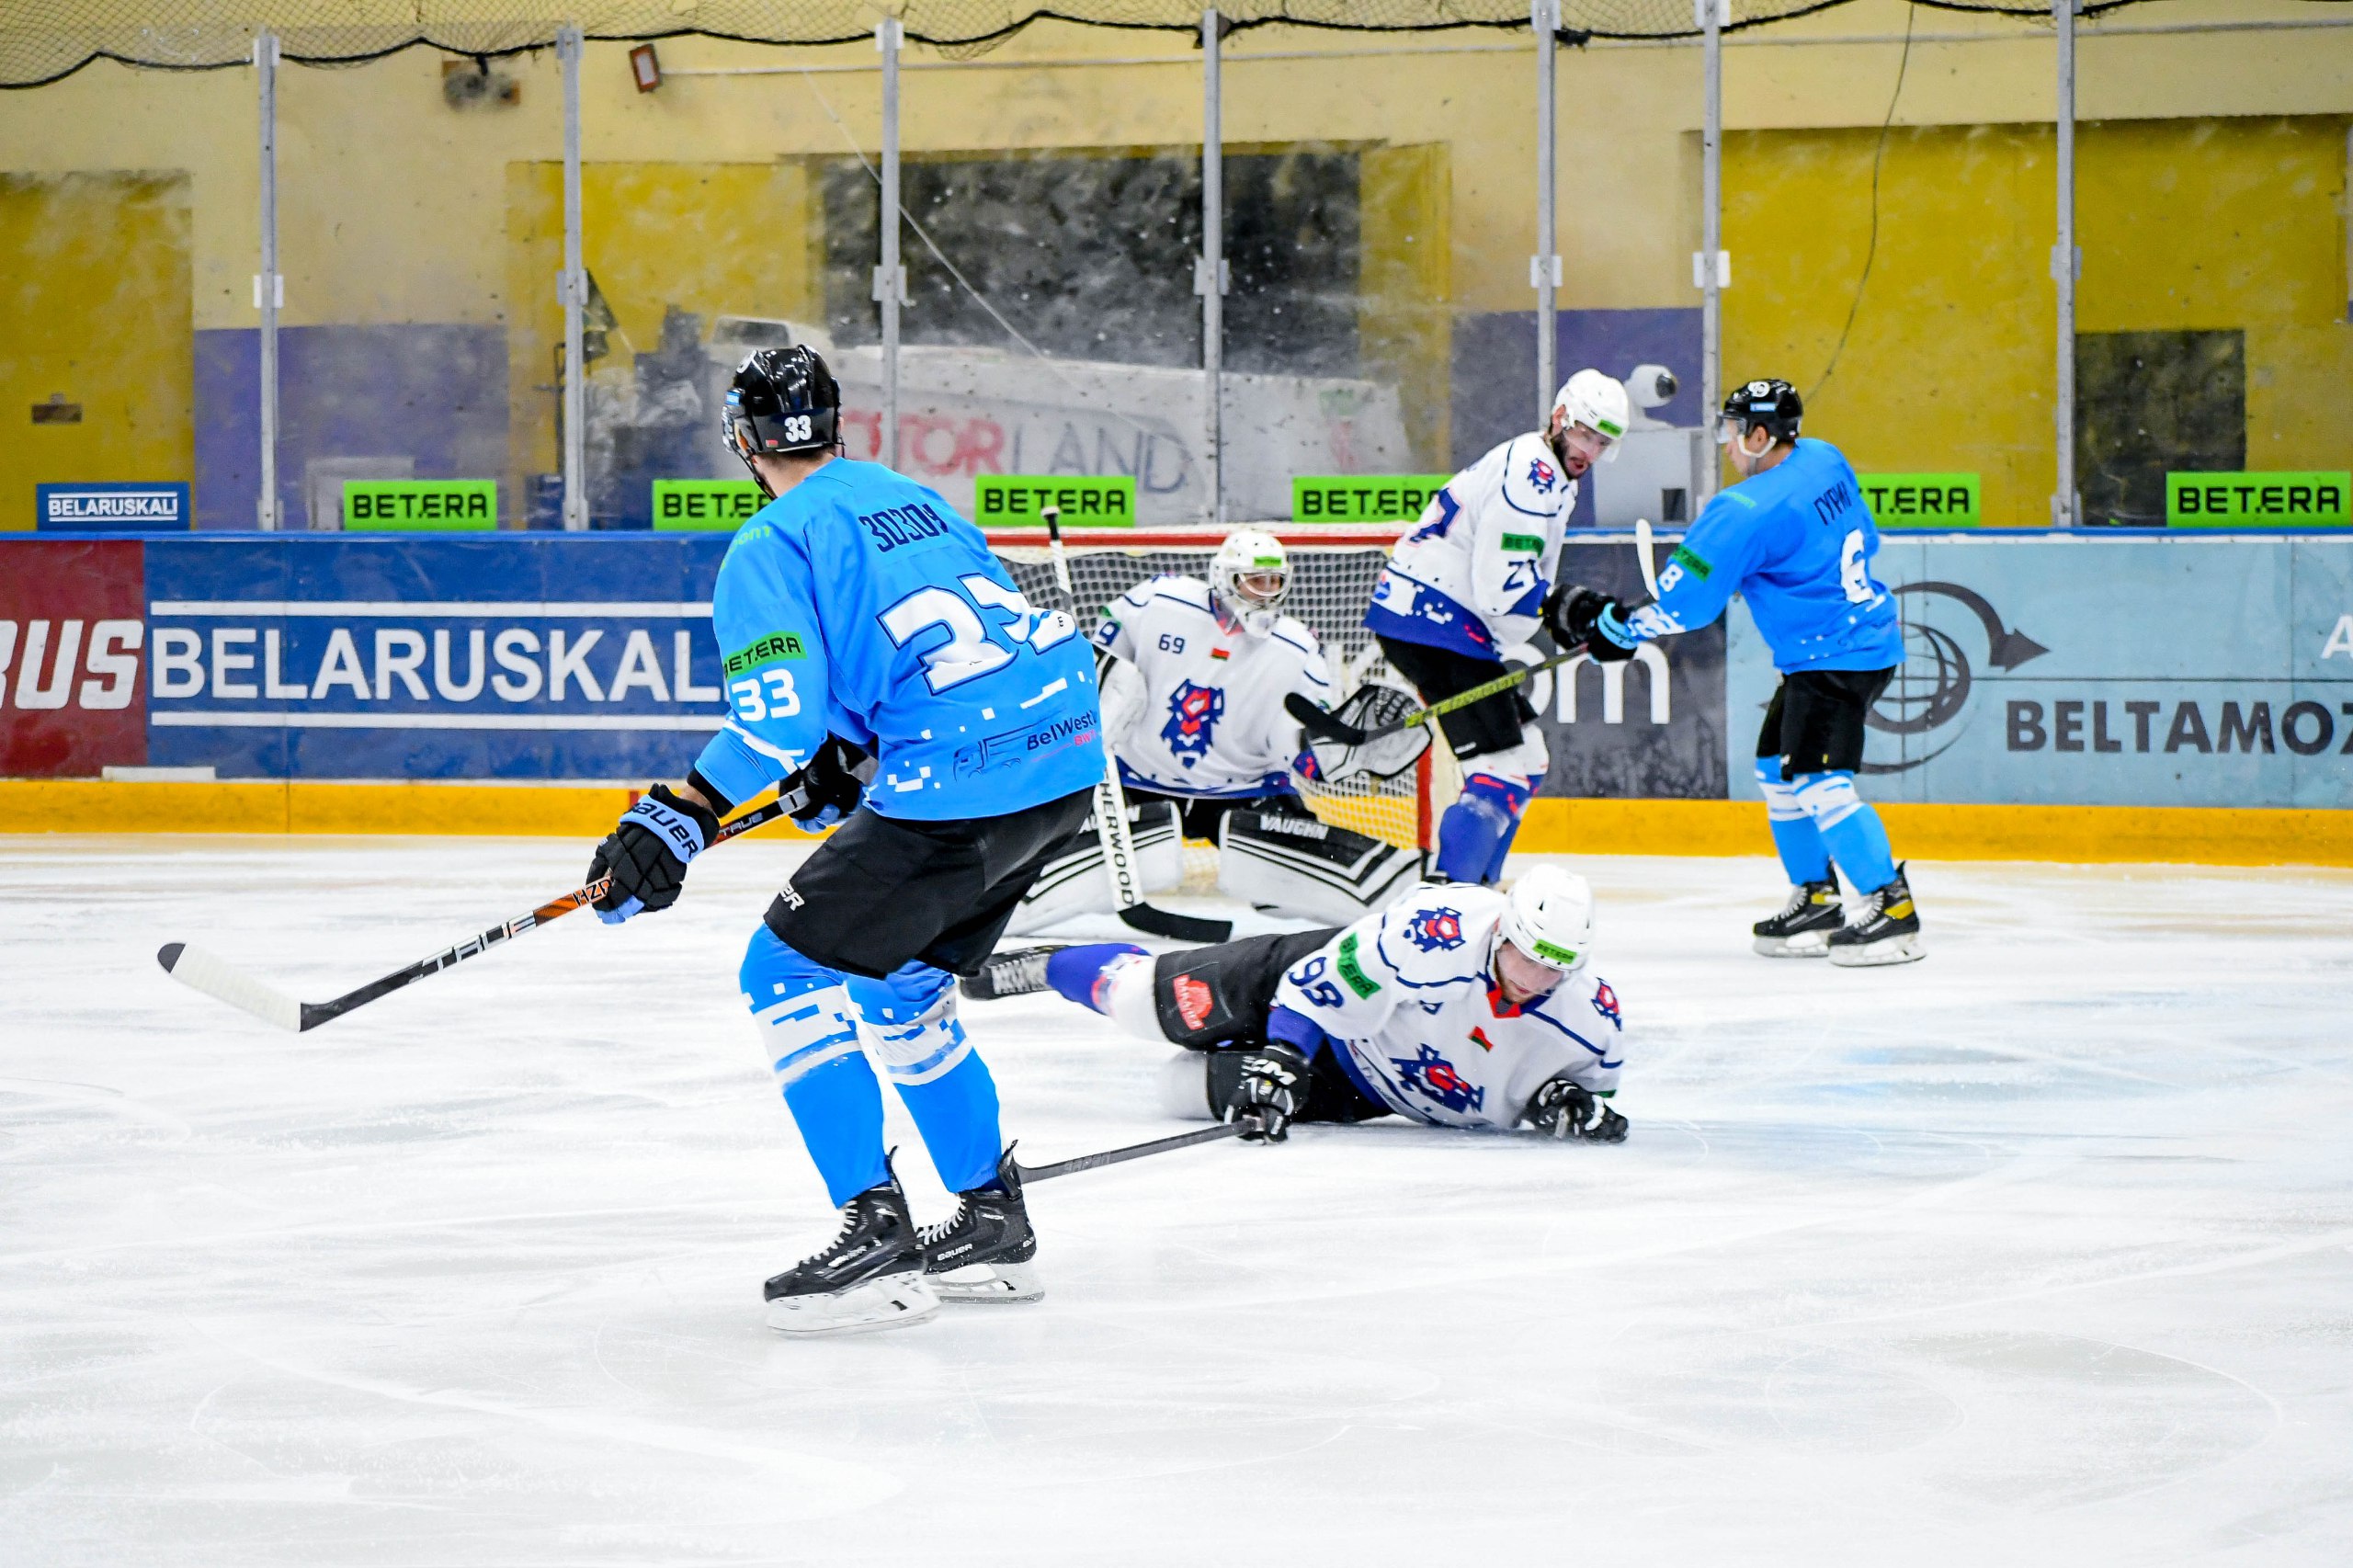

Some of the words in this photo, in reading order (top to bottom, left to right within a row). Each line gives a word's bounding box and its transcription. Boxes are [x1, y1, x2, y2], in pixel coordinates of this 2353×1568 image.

[784, 415, 812, 442] 33
[49, 498, 177, 516] BELARUSKALI
[1159, 633, 1186, 654] 69
[152, 627, 729, 702] BELARUSKAL
[731, 668, 801, 722] 33
[1100, 767, 1134, 905] HERWOOD
[1260, 814, 1329, 840] VAUGHN
[422, 911, 537, 971] TRUE
